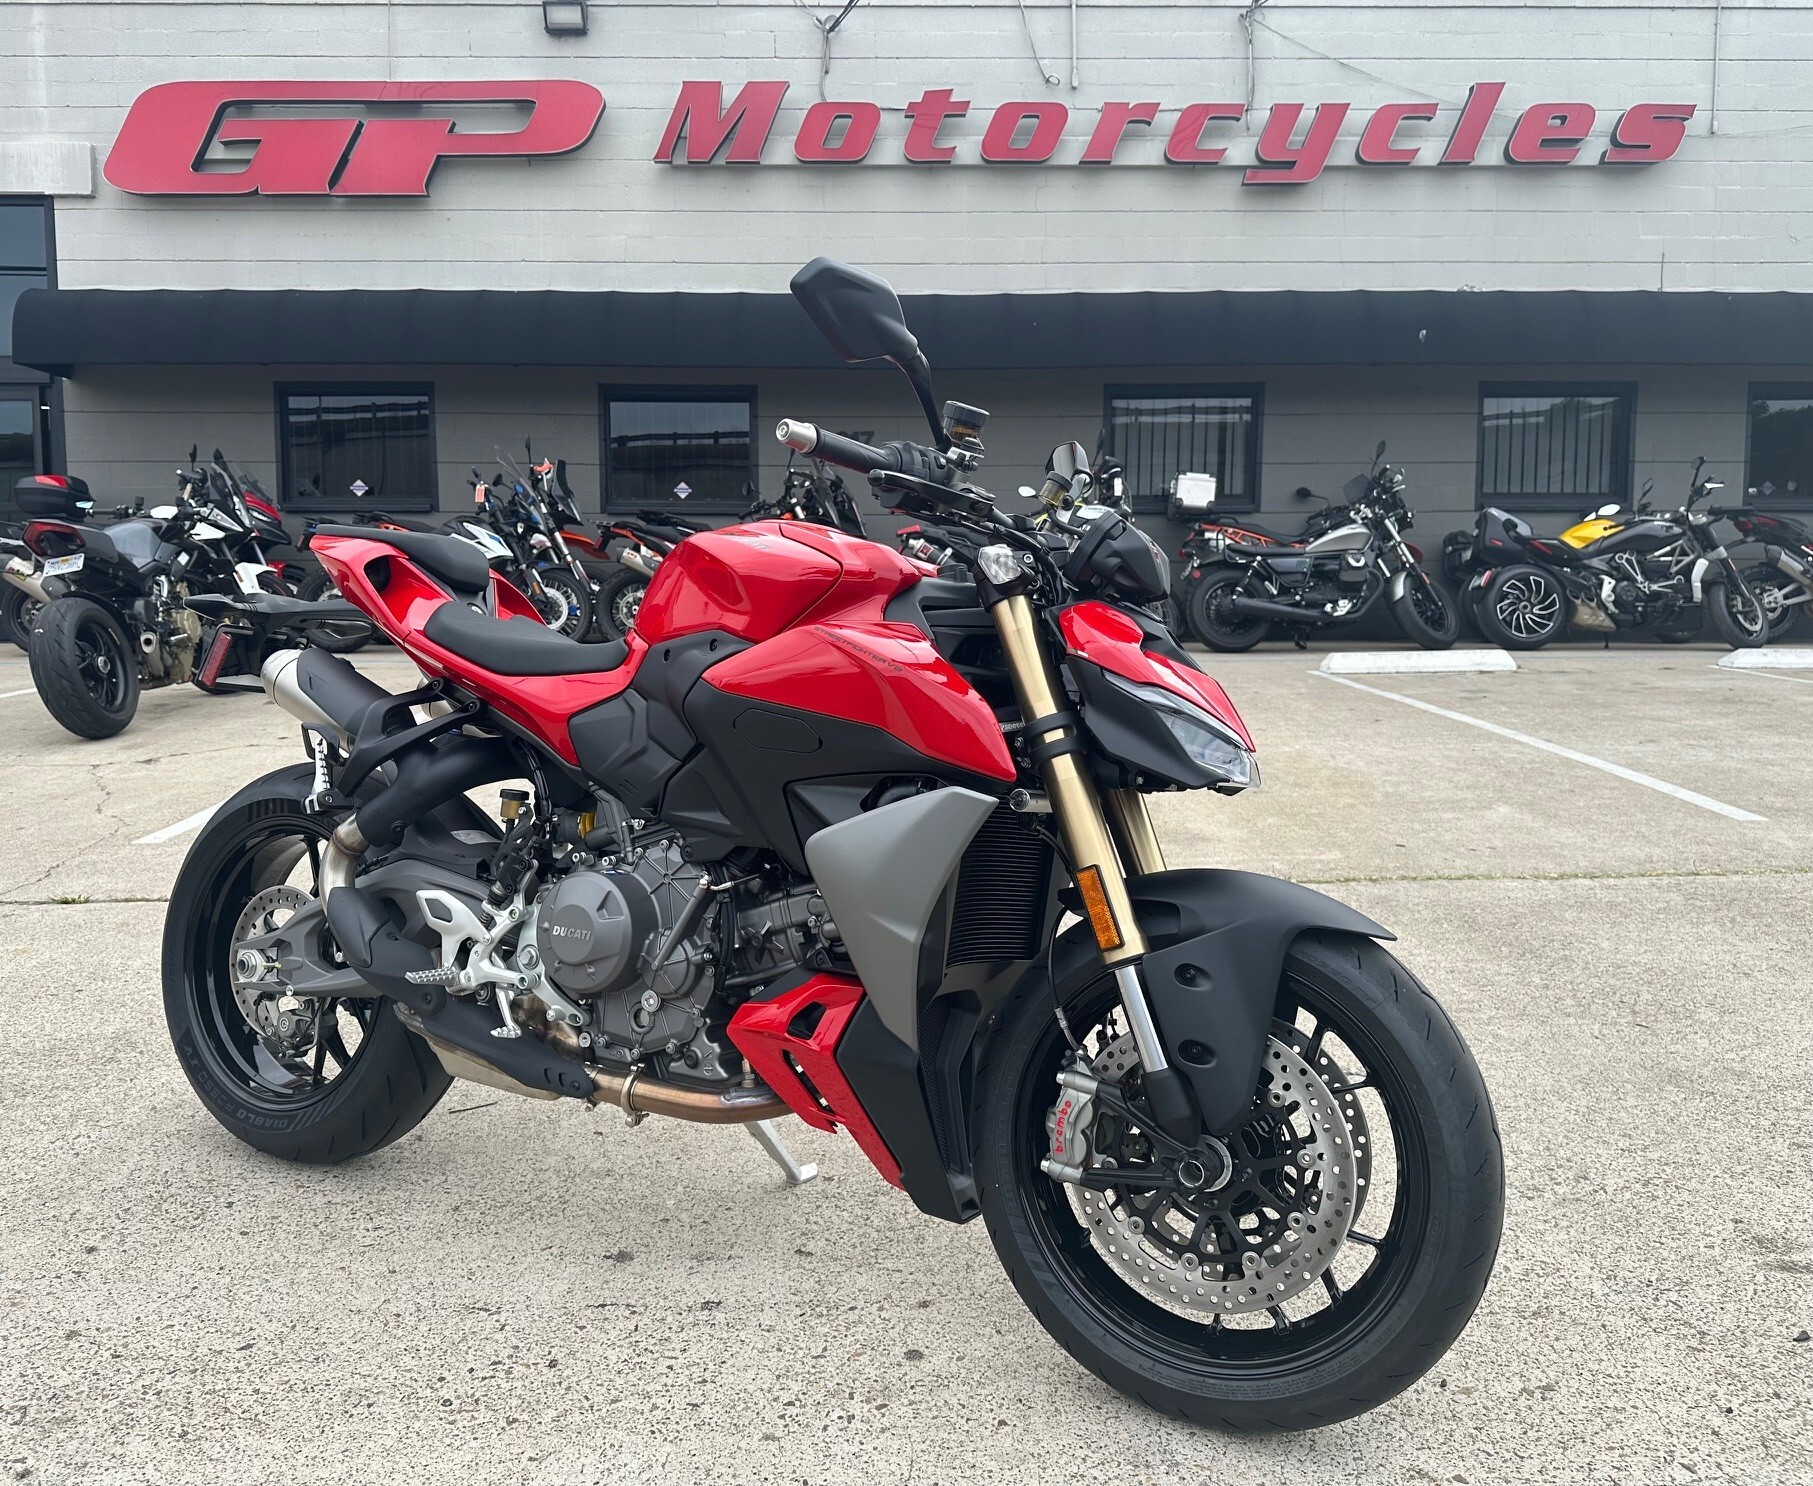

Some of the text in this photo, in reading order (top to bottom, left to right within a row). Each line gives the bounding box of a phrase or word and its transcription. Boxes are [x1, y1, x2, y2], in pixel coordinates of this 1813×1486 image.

[102, 79, 1697, 195] GP Motorcycles
[813, 625, 887, 665] STREETFIGHTER
[552, 925, 592, 941] DUCATI
[236, 1108, 289, 1129] DIABLO
[1054, 1100, 1072, 1154] brembo
